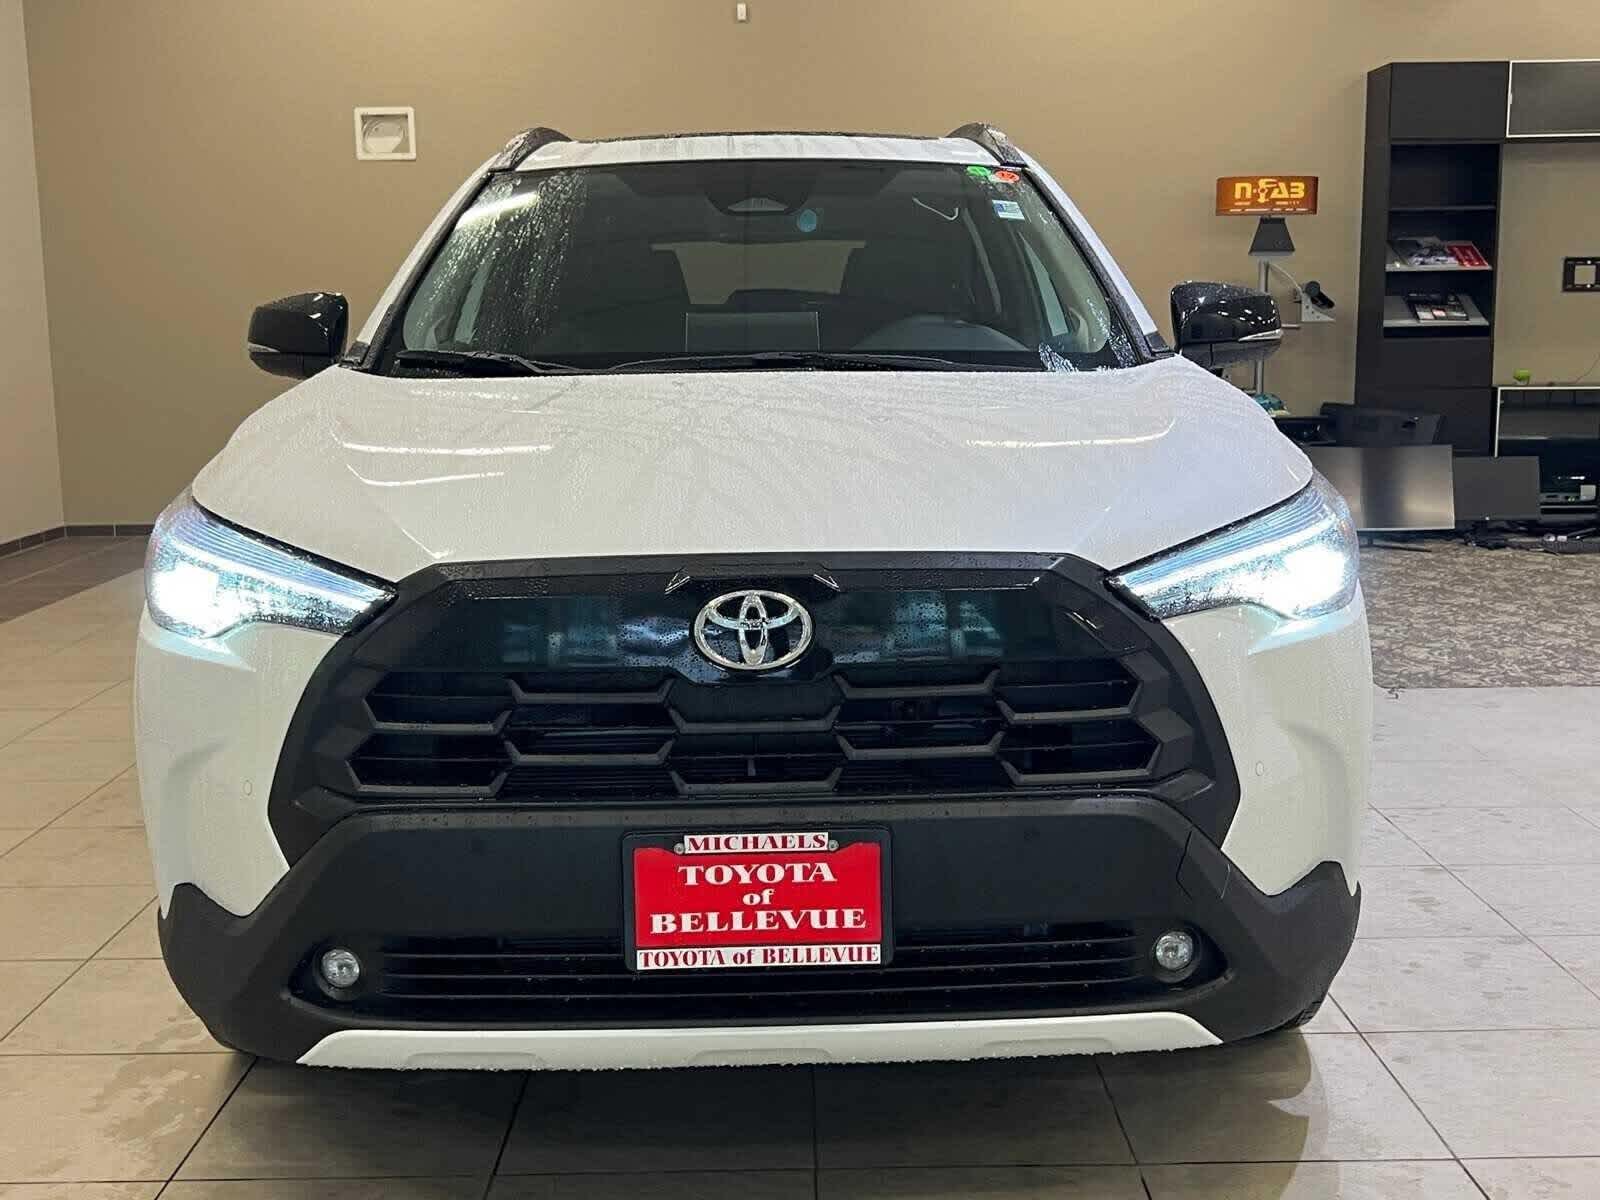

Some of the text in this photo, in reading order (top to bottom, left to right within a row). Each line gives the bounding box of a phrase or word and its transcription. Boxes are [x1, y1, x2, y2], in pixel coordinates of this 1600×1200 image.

[688, 834, 826, 851] MICHAELS
[678, 862, 837, 886] TOYOTA
[742, 888, 775, 905] of
[649, 908, 866, 934] BELLEVUE
[640, 946, 879, 968] TOYOTA of BELLEVUE
